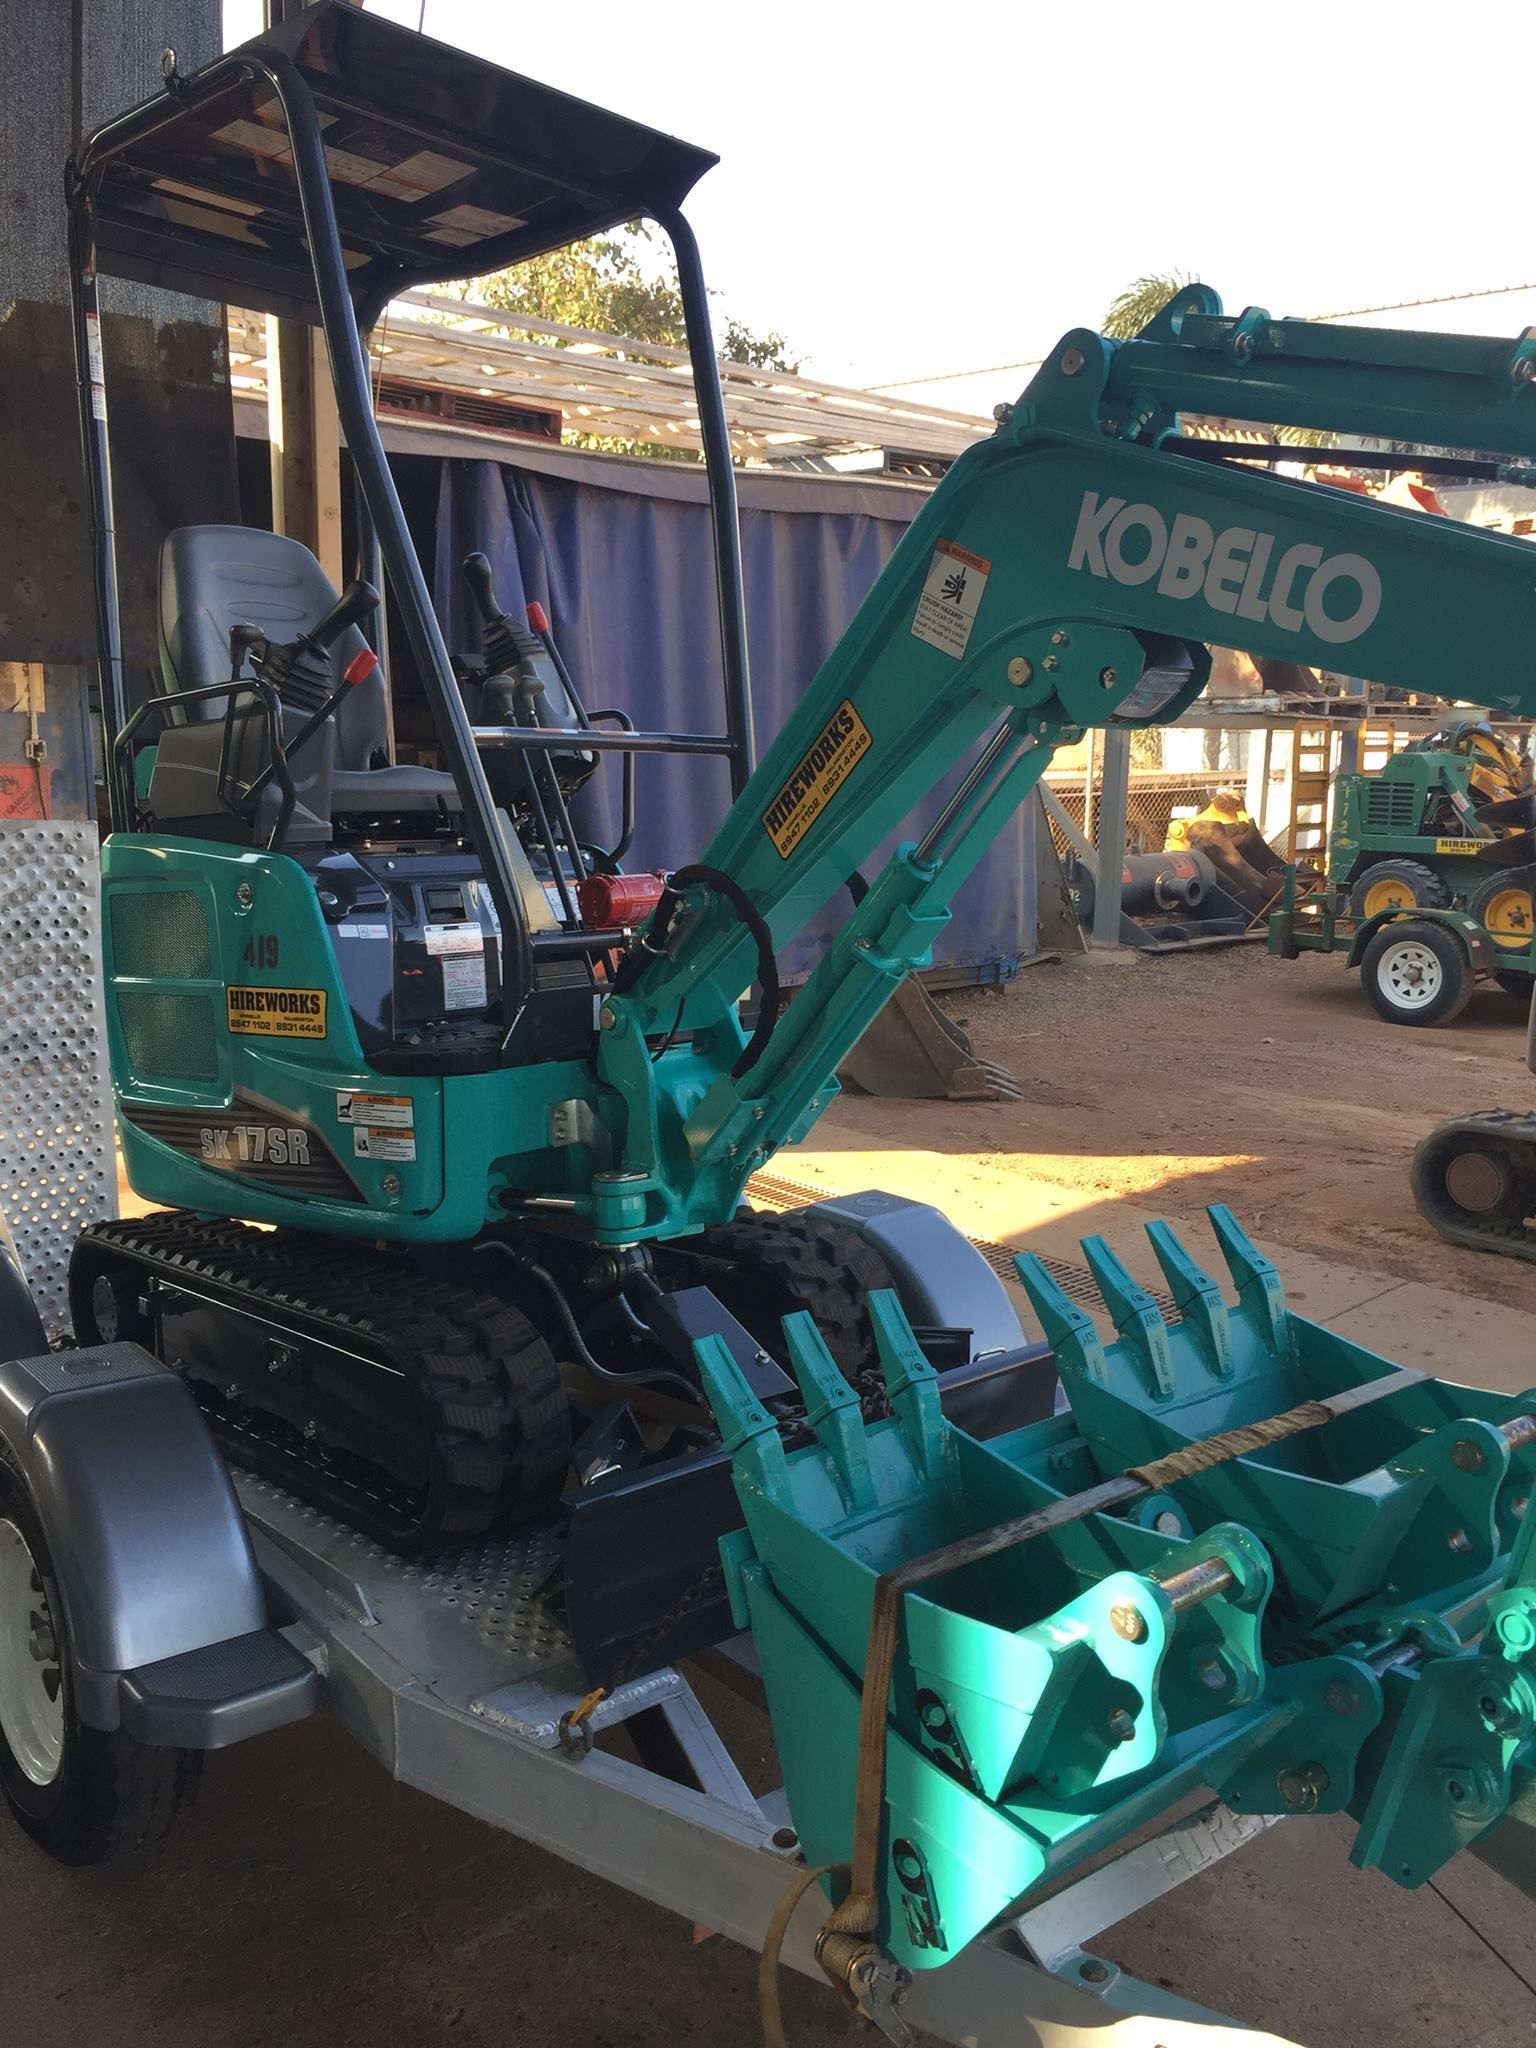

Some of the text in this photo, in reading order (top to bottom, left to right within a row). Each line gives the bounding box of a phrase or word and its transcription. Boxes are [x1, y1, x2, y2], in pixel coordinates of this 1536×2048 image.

[950, 545, 983, 568] WARNING
[1067, 490, 1383, 644] KOBELCO
[922, 595, 941, 608] CRUSH
[766, 708, 854, 836] HIREWORKS
[822, 733, 867, 795] 8931 4449
[801, 798, 820, 823] 1102
[243, 934, 279, 969] 419
[229, 990, 320, 1015] HIREWORKS
[252, 1021, 271, 1030] 1102
